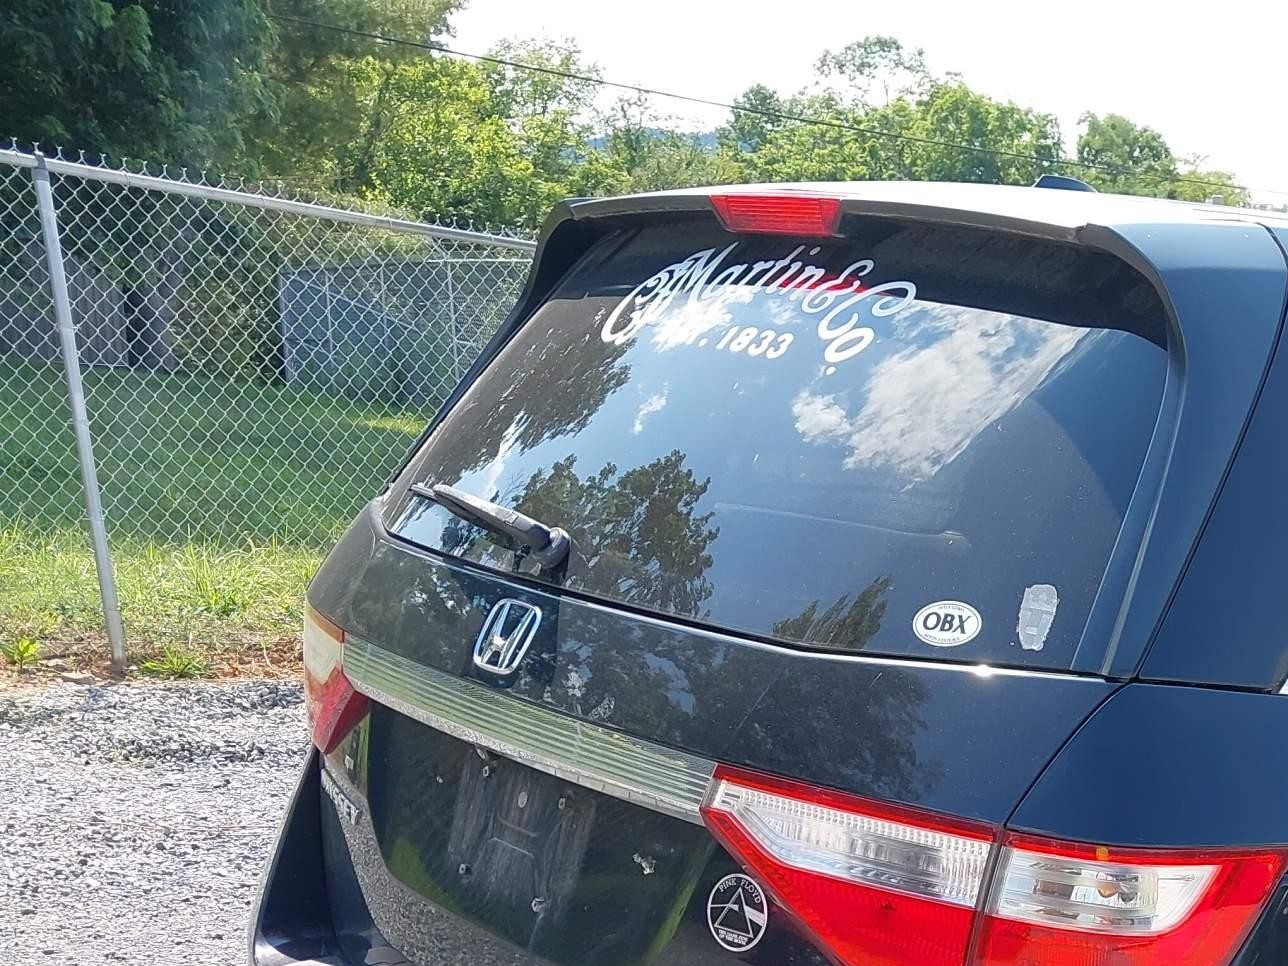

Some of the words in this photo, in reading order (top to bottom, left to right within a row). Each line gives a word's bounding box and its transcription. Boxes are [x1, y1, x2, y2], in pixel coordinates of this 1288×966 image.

[802, 260, 874, 313] &
[715, 326, 794, 359] 1833
[923, 611, 971, 634] OBX
[719, 878, 737, 892] PINK
[741, 880, 761, 904] FLOYD
